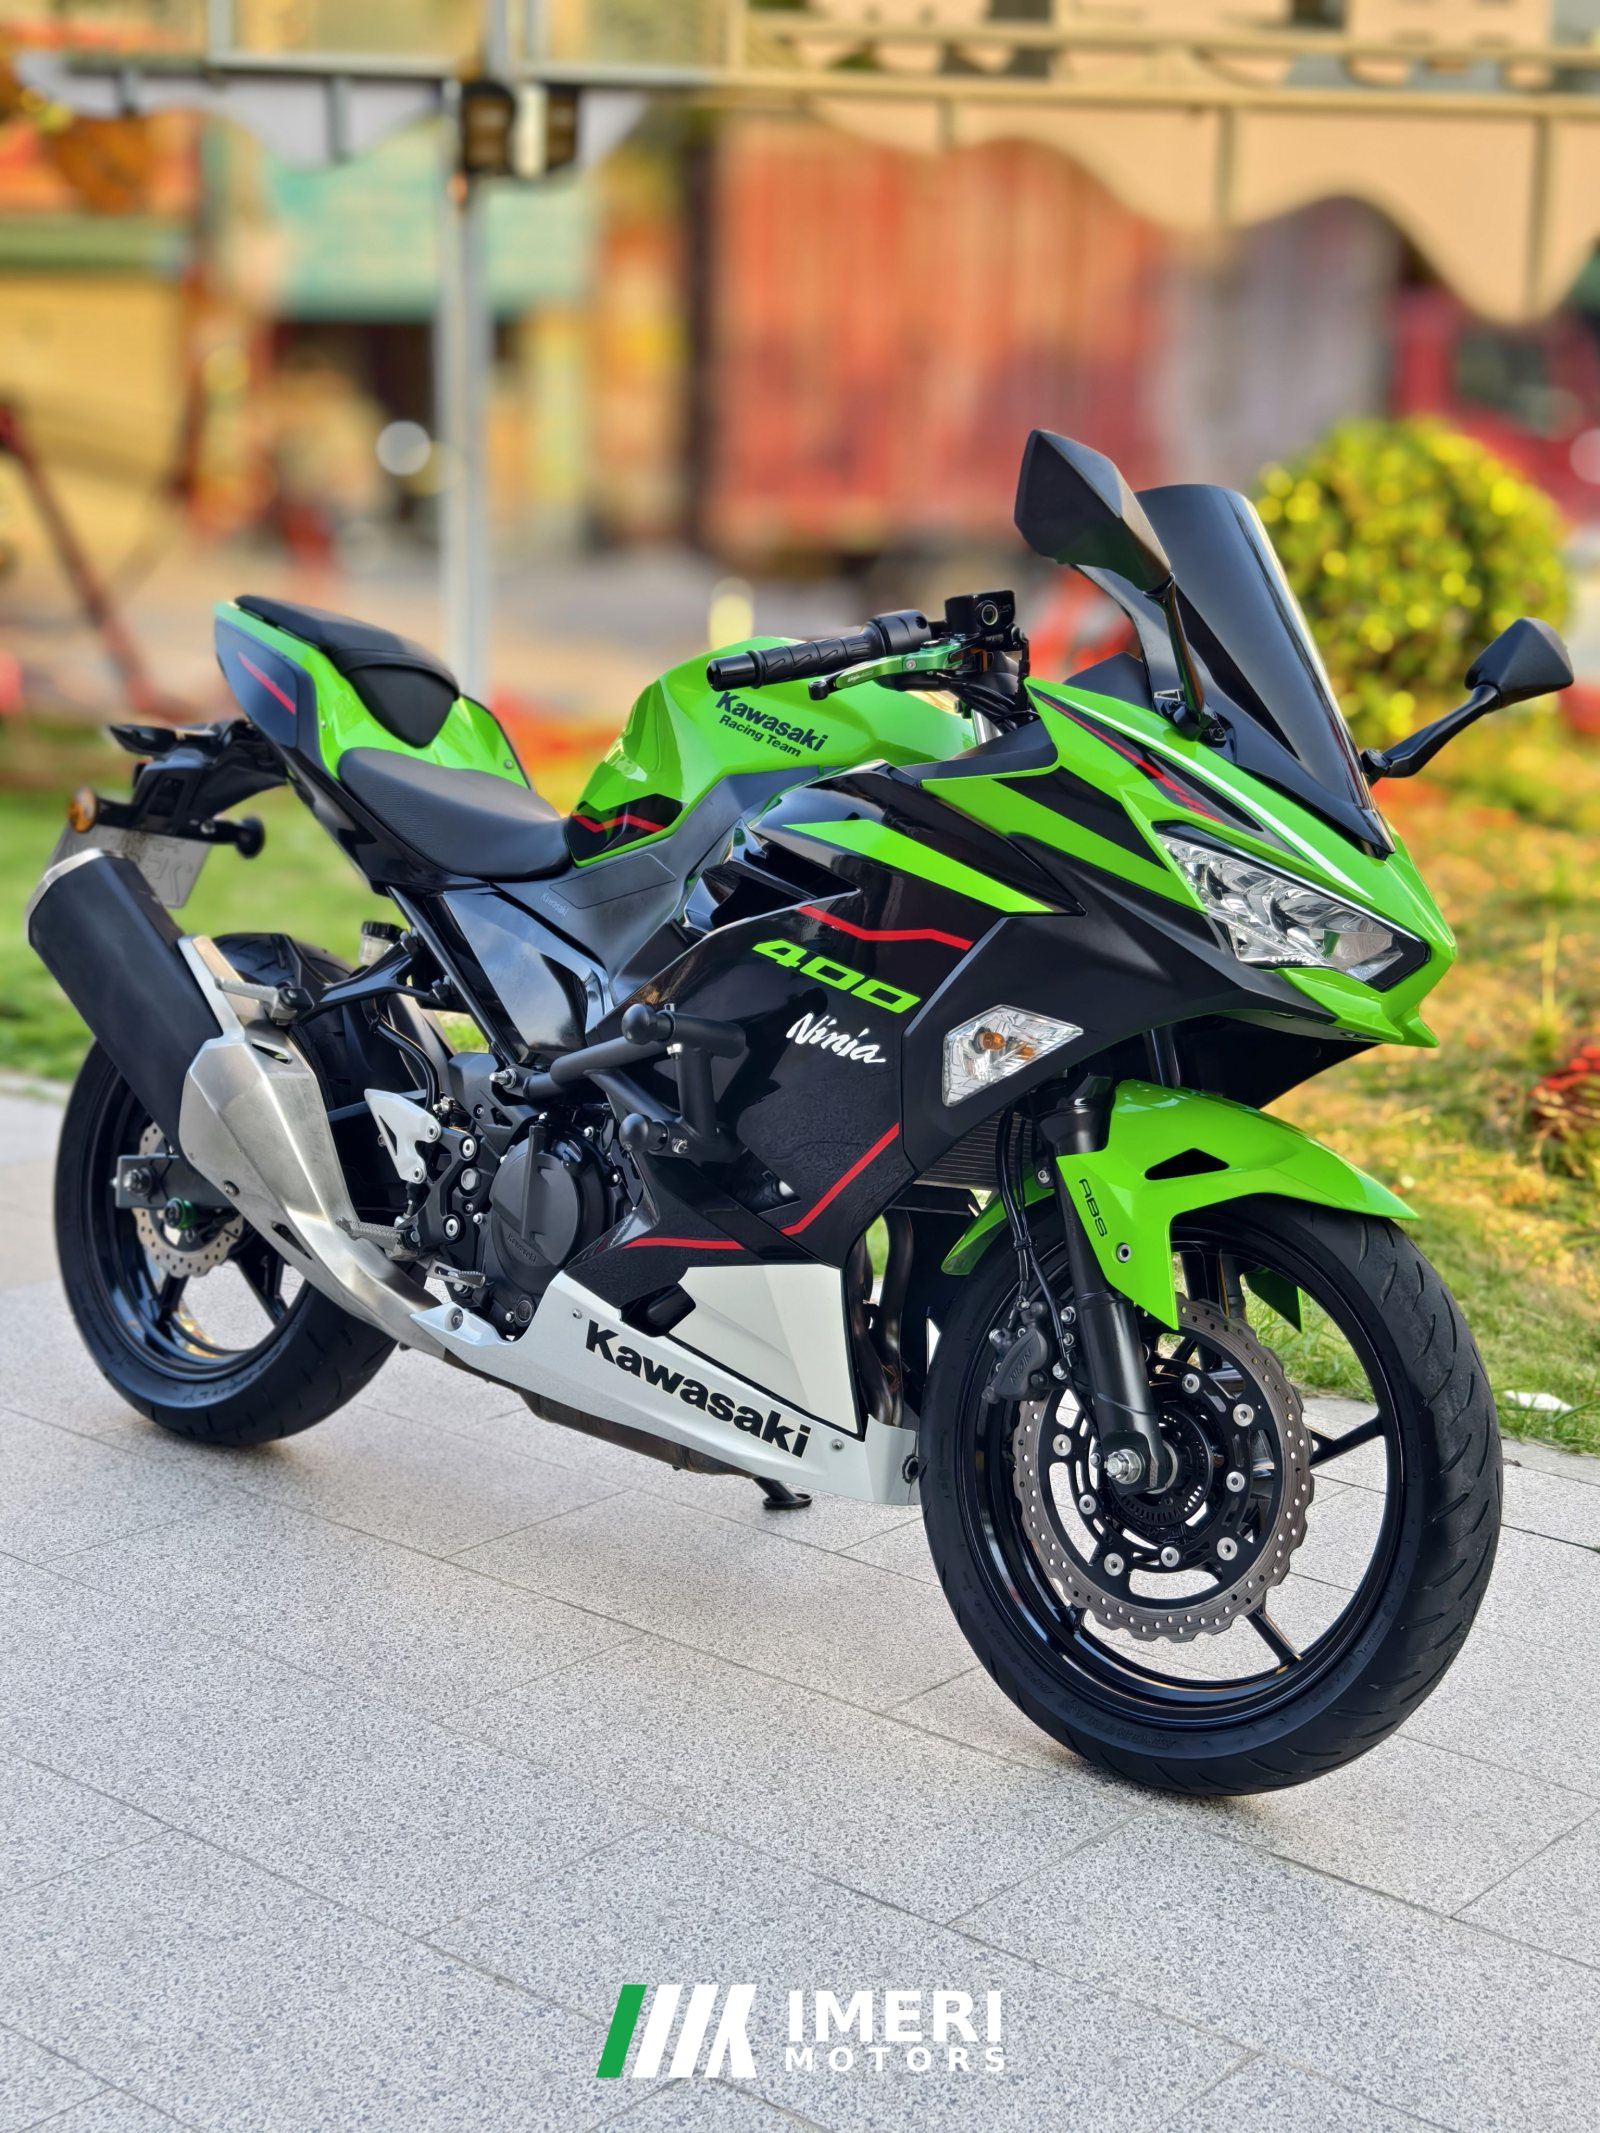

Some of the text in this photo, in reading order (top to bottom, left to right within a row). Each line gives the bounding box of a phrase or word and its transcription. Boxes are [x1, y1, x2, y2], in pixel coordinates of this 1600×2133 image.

[715, 691, 829, 752] Kawasaki
[719, 714, 802, 757] Racing Team
[752, 939, 921, 1014] 400
[785, 1012, 887, 1064] Ninja
[1079, 1178, 1108, 1237] ABS
[585, 1319, 811, 1459] Kawasaki
